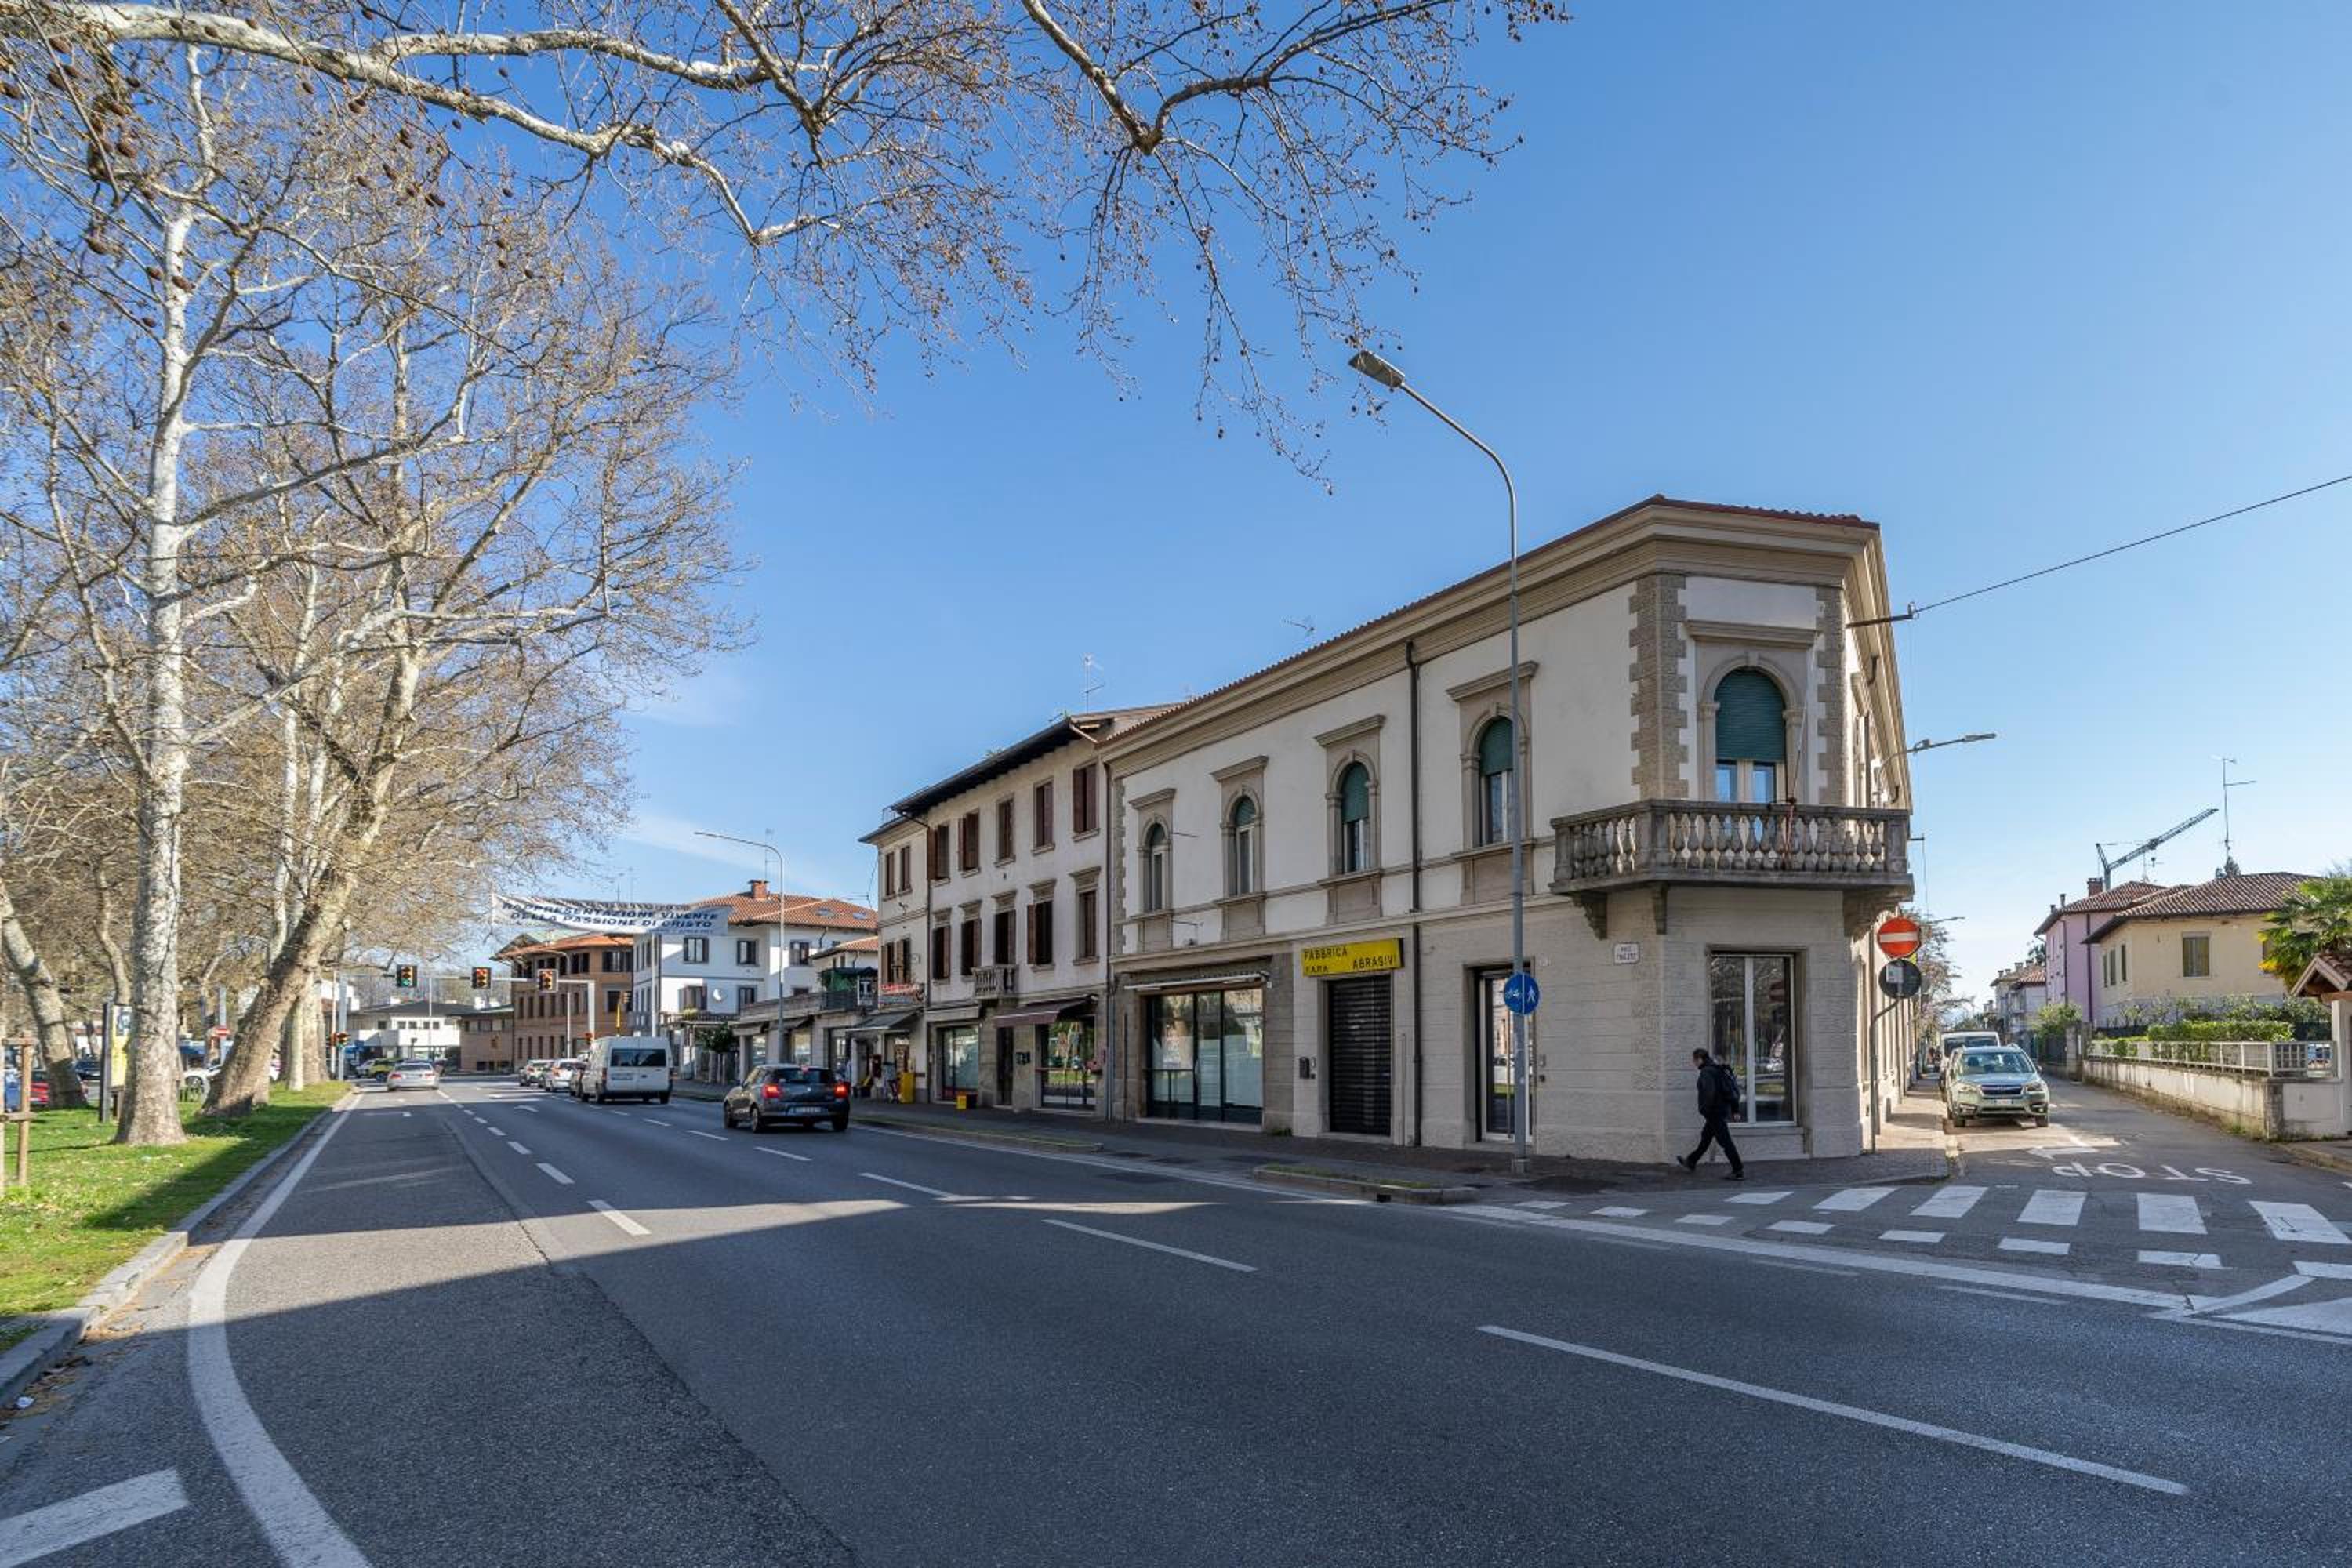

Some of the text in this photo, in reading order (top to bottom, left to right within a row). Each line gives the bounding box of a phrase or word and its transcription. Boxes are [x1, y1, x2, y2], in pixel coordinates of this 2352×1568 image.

[510, 912, 557, 922] DELLA
[564, 916, 636, 926] PASSIONE
[661, 911, 718, 920] VIVENTE
[1304, 946, 1348, 961] FABBRICA
[1352, 953, 1396, 970] ABRASIVI
[2052, 1161, 2252, 1185] STOP
